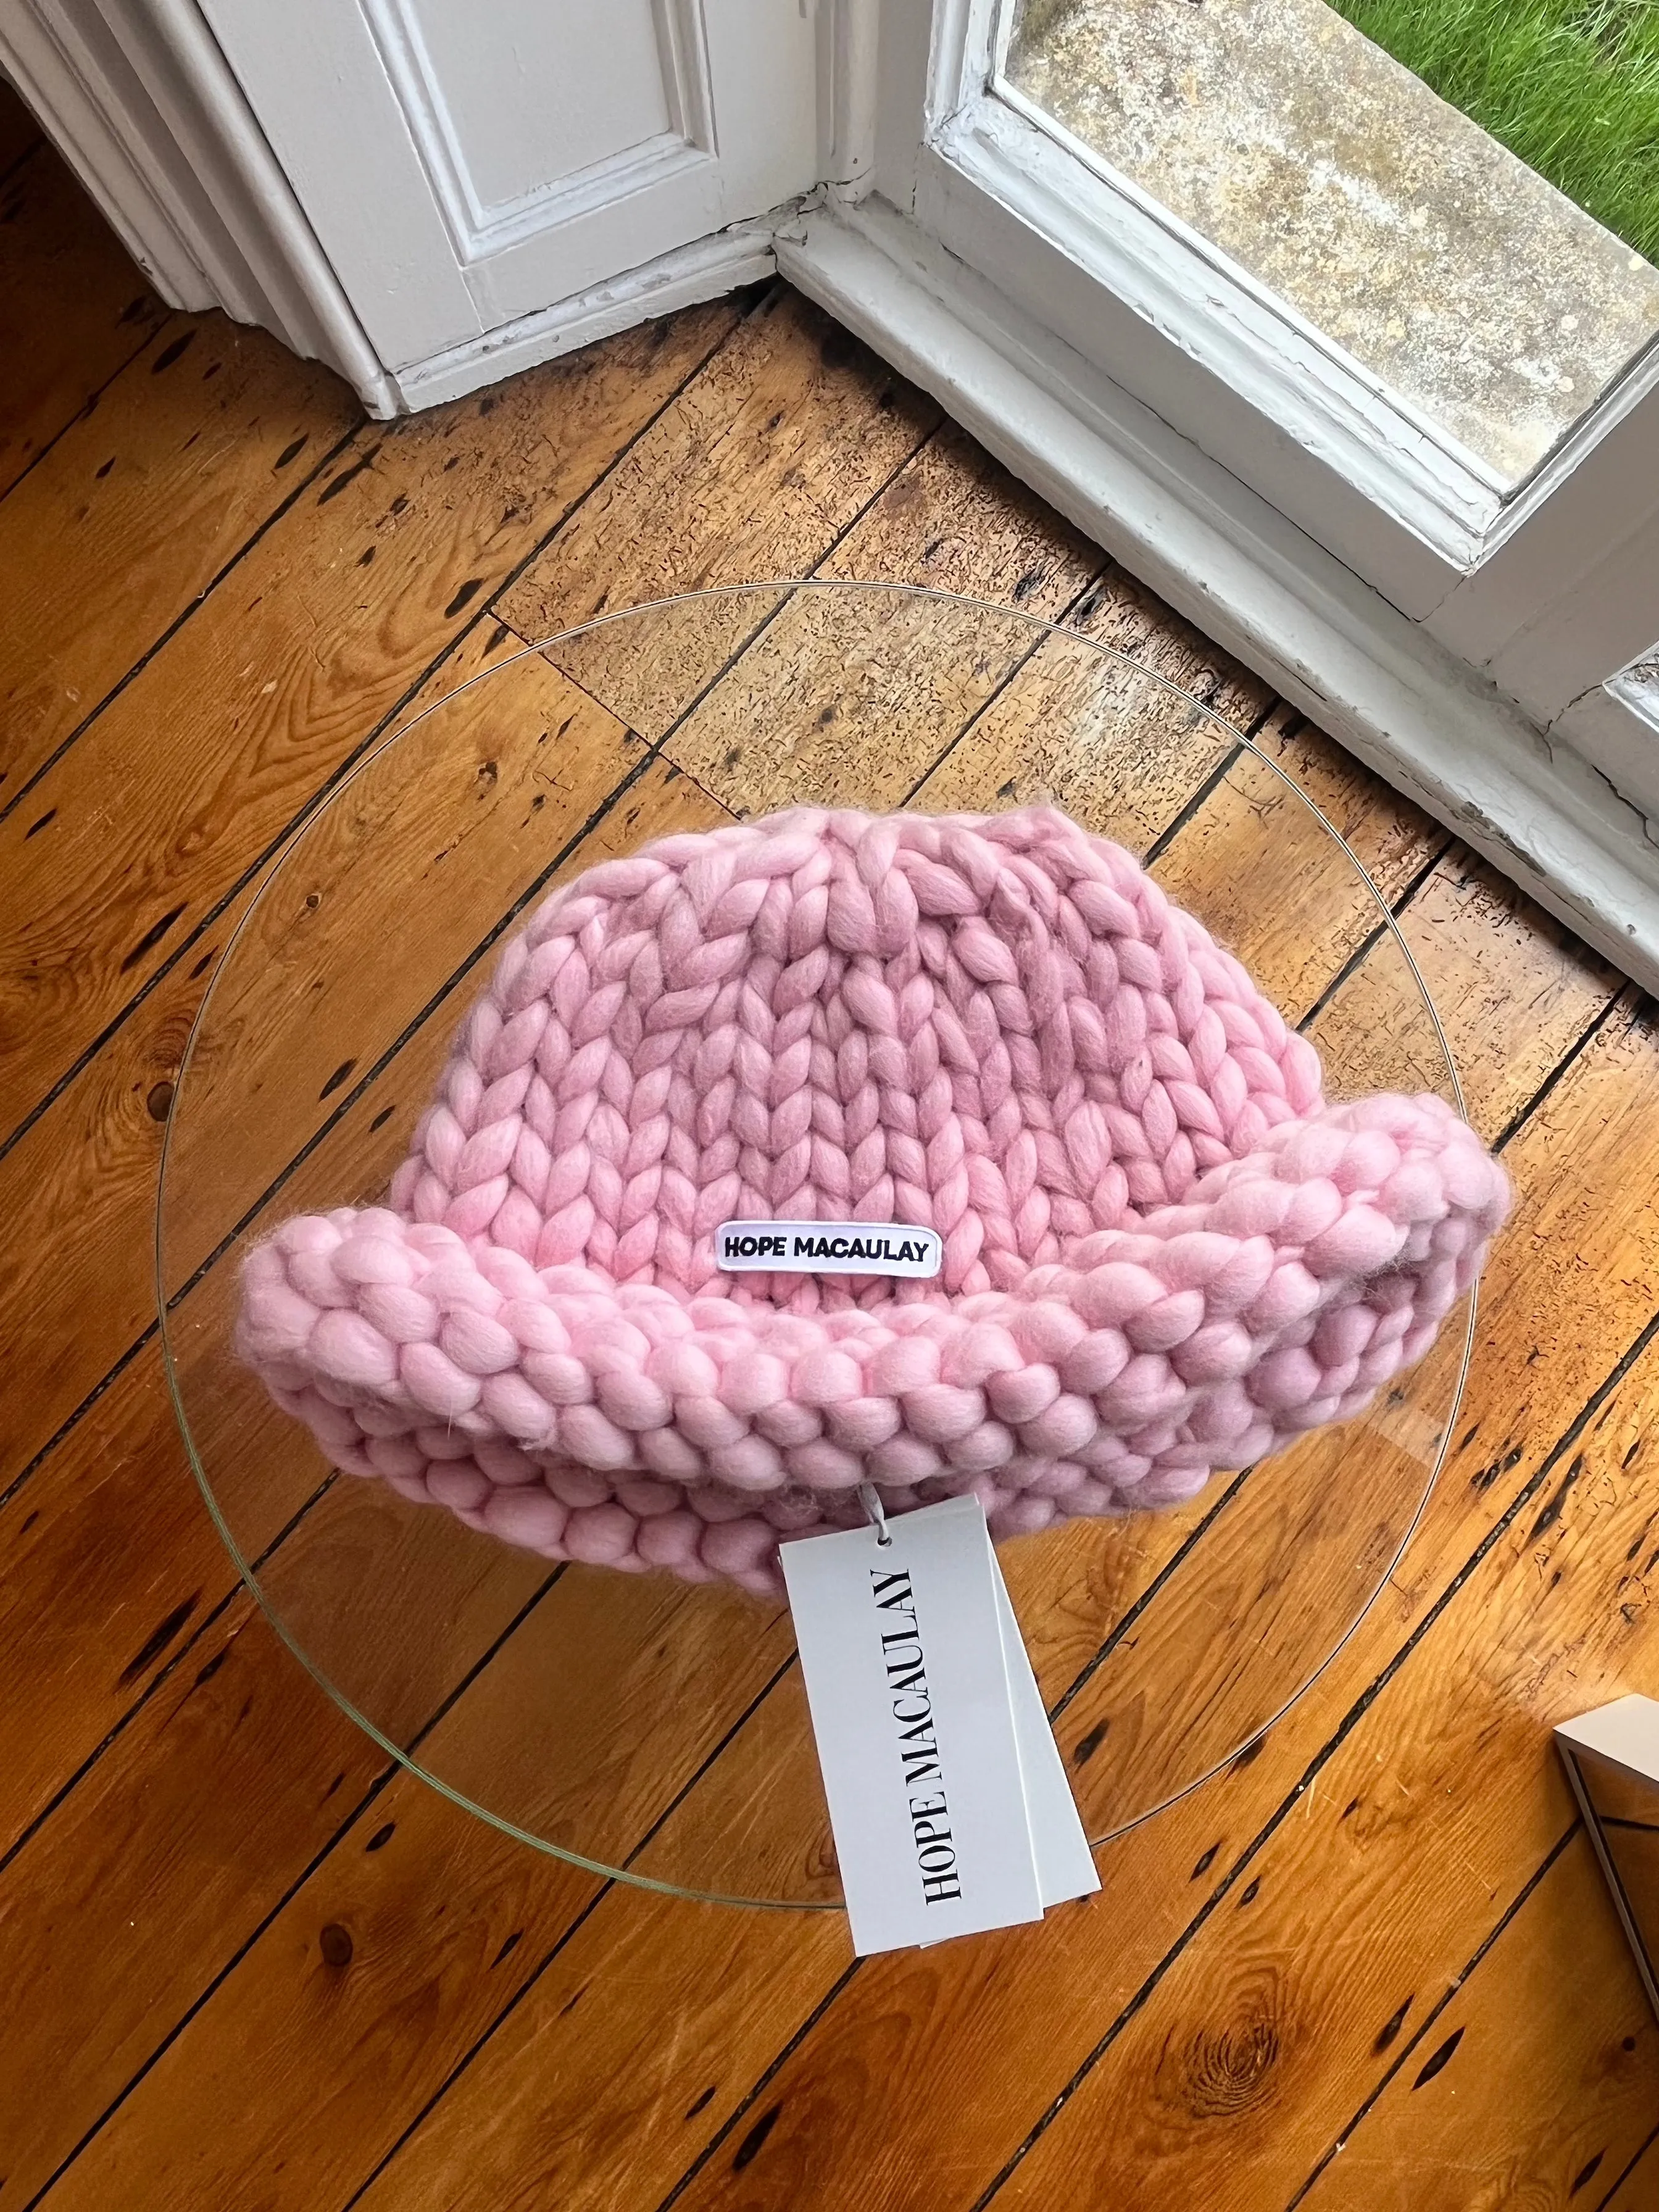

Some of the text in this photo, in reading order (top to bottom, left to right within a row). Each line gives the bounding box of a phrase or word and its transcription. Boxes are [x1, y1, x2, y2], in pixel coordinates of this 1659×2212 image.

[725, 1236, 929, 1262] HOPE MACAULAY
[870, 1569, 962, 1906] HOPE MACAULAY
